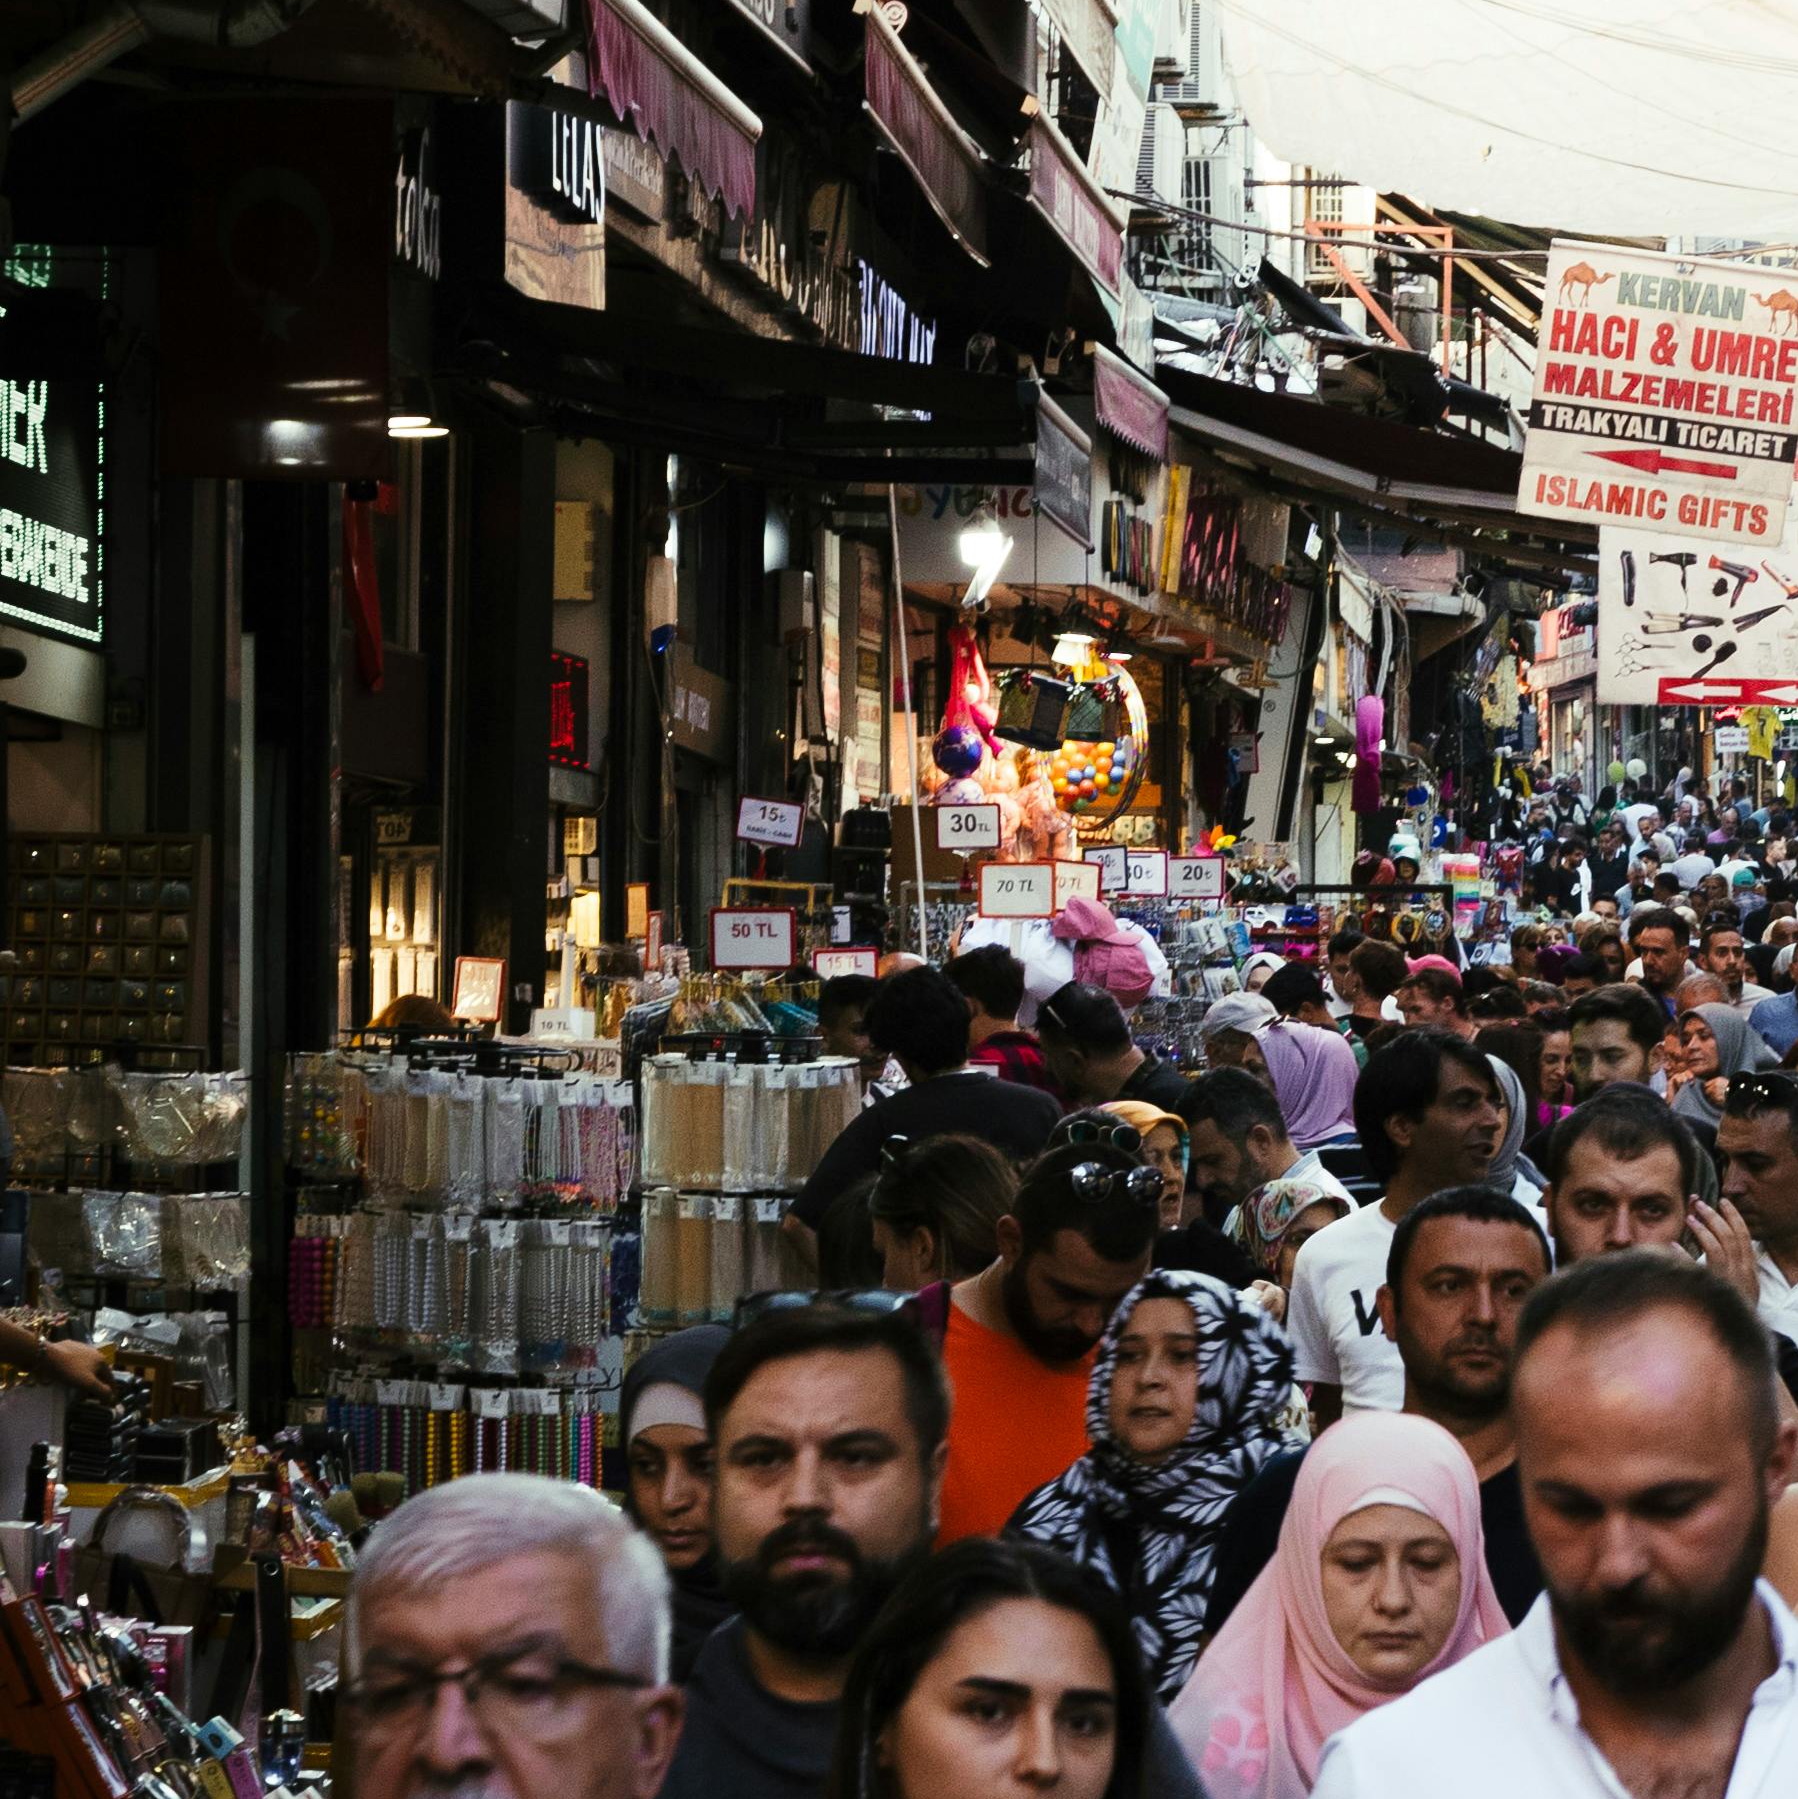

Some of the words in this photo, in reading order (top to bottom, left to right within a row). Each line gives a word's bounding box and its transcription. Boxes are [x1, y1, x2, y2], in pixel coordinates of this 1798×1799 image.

[1617, 271, 1746, 321] KERVAN
[1549, 308, 1640, 362] HACI
[1650, 323, 1678, 366] &
[1544, 362, 1794, 425] MALZEMELERİ
[1541, 404, 1668, 443] TRAKYALI
[1535, 474, 1667, 520] ISLAMIC
[1678, 494, 1768, 535] GIFTS
[1019, 879, 1035, 893] TL
[731, 923, 750, 938] 50
[755, 923, 778, 938] TL
[846, 956, 863, 970] TL
[557, 1021, 569, 1031] TL
